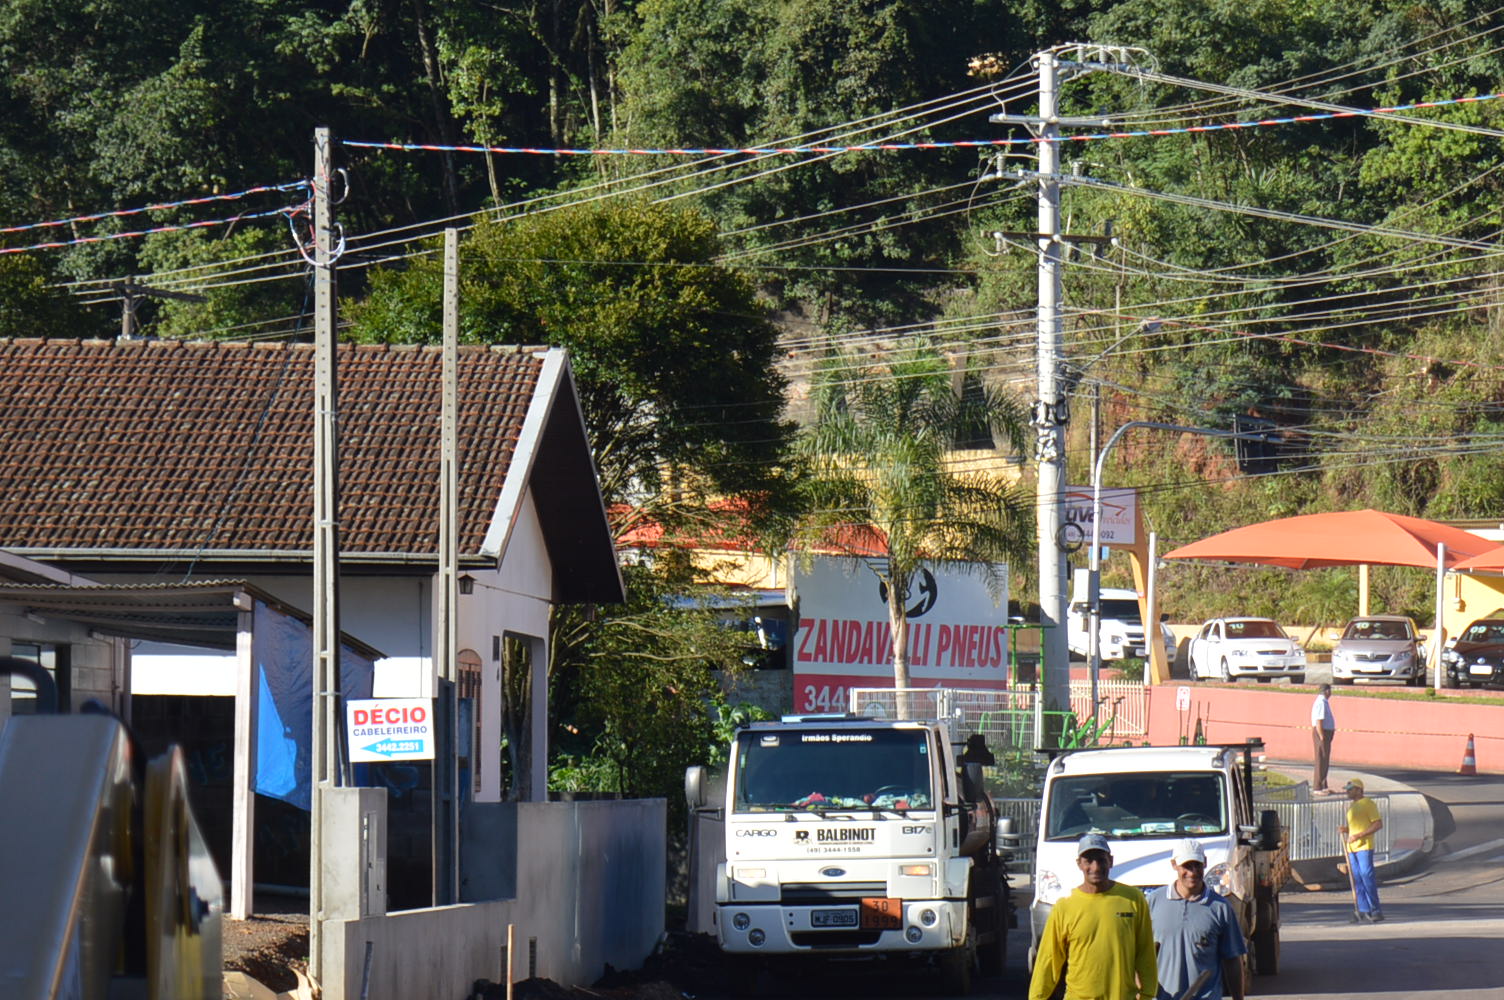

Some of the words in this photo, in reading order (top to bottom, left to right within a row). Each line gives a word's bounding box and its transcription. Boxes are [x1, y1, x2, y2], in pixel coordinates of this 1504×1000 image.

[935, 623, 1005, 668] PNEUS
[804, 685, 851, 713] 344
[353, 704, 427, 726] DÉCIO
[353, 726, 428, 736] CABELEIREIRO
[736, 829, 778, 837] CARGO
[817, 828, 877, 842] BALBINOT
[872, 901, 889, 912] 30
